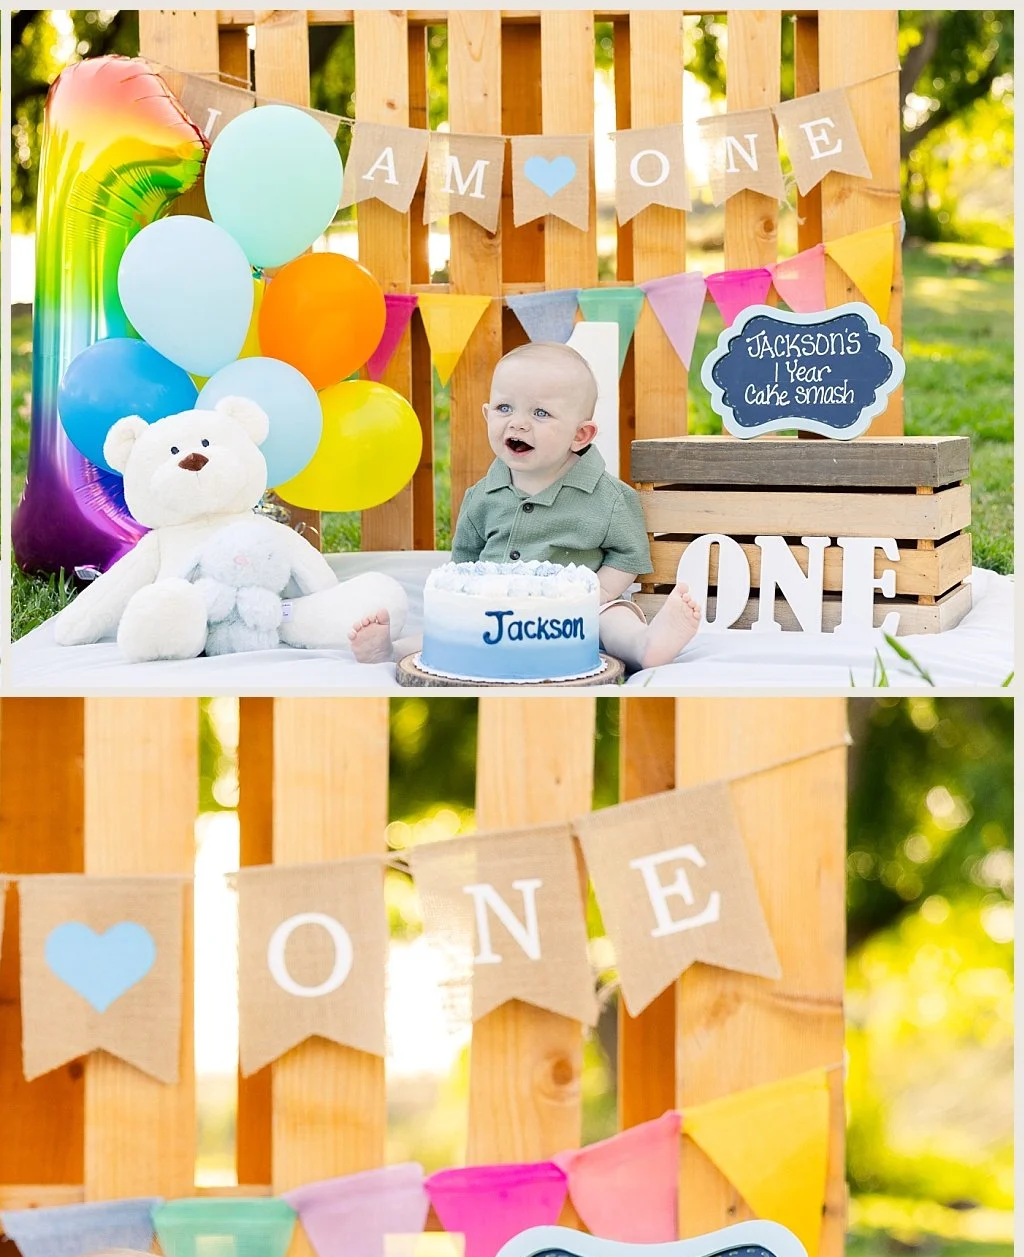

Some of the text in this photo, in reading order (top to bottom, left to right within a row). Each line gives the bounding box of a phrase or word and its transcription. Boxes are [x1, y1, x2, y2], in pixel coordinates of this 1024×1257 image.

[629, 117, 842, 187] ONE
[785, 359, 832, 383] Year
[676, 533, 901, 636] ONE
[483, 610, 585, 645] Jackson
[267, 843, 721, 997] ONE
